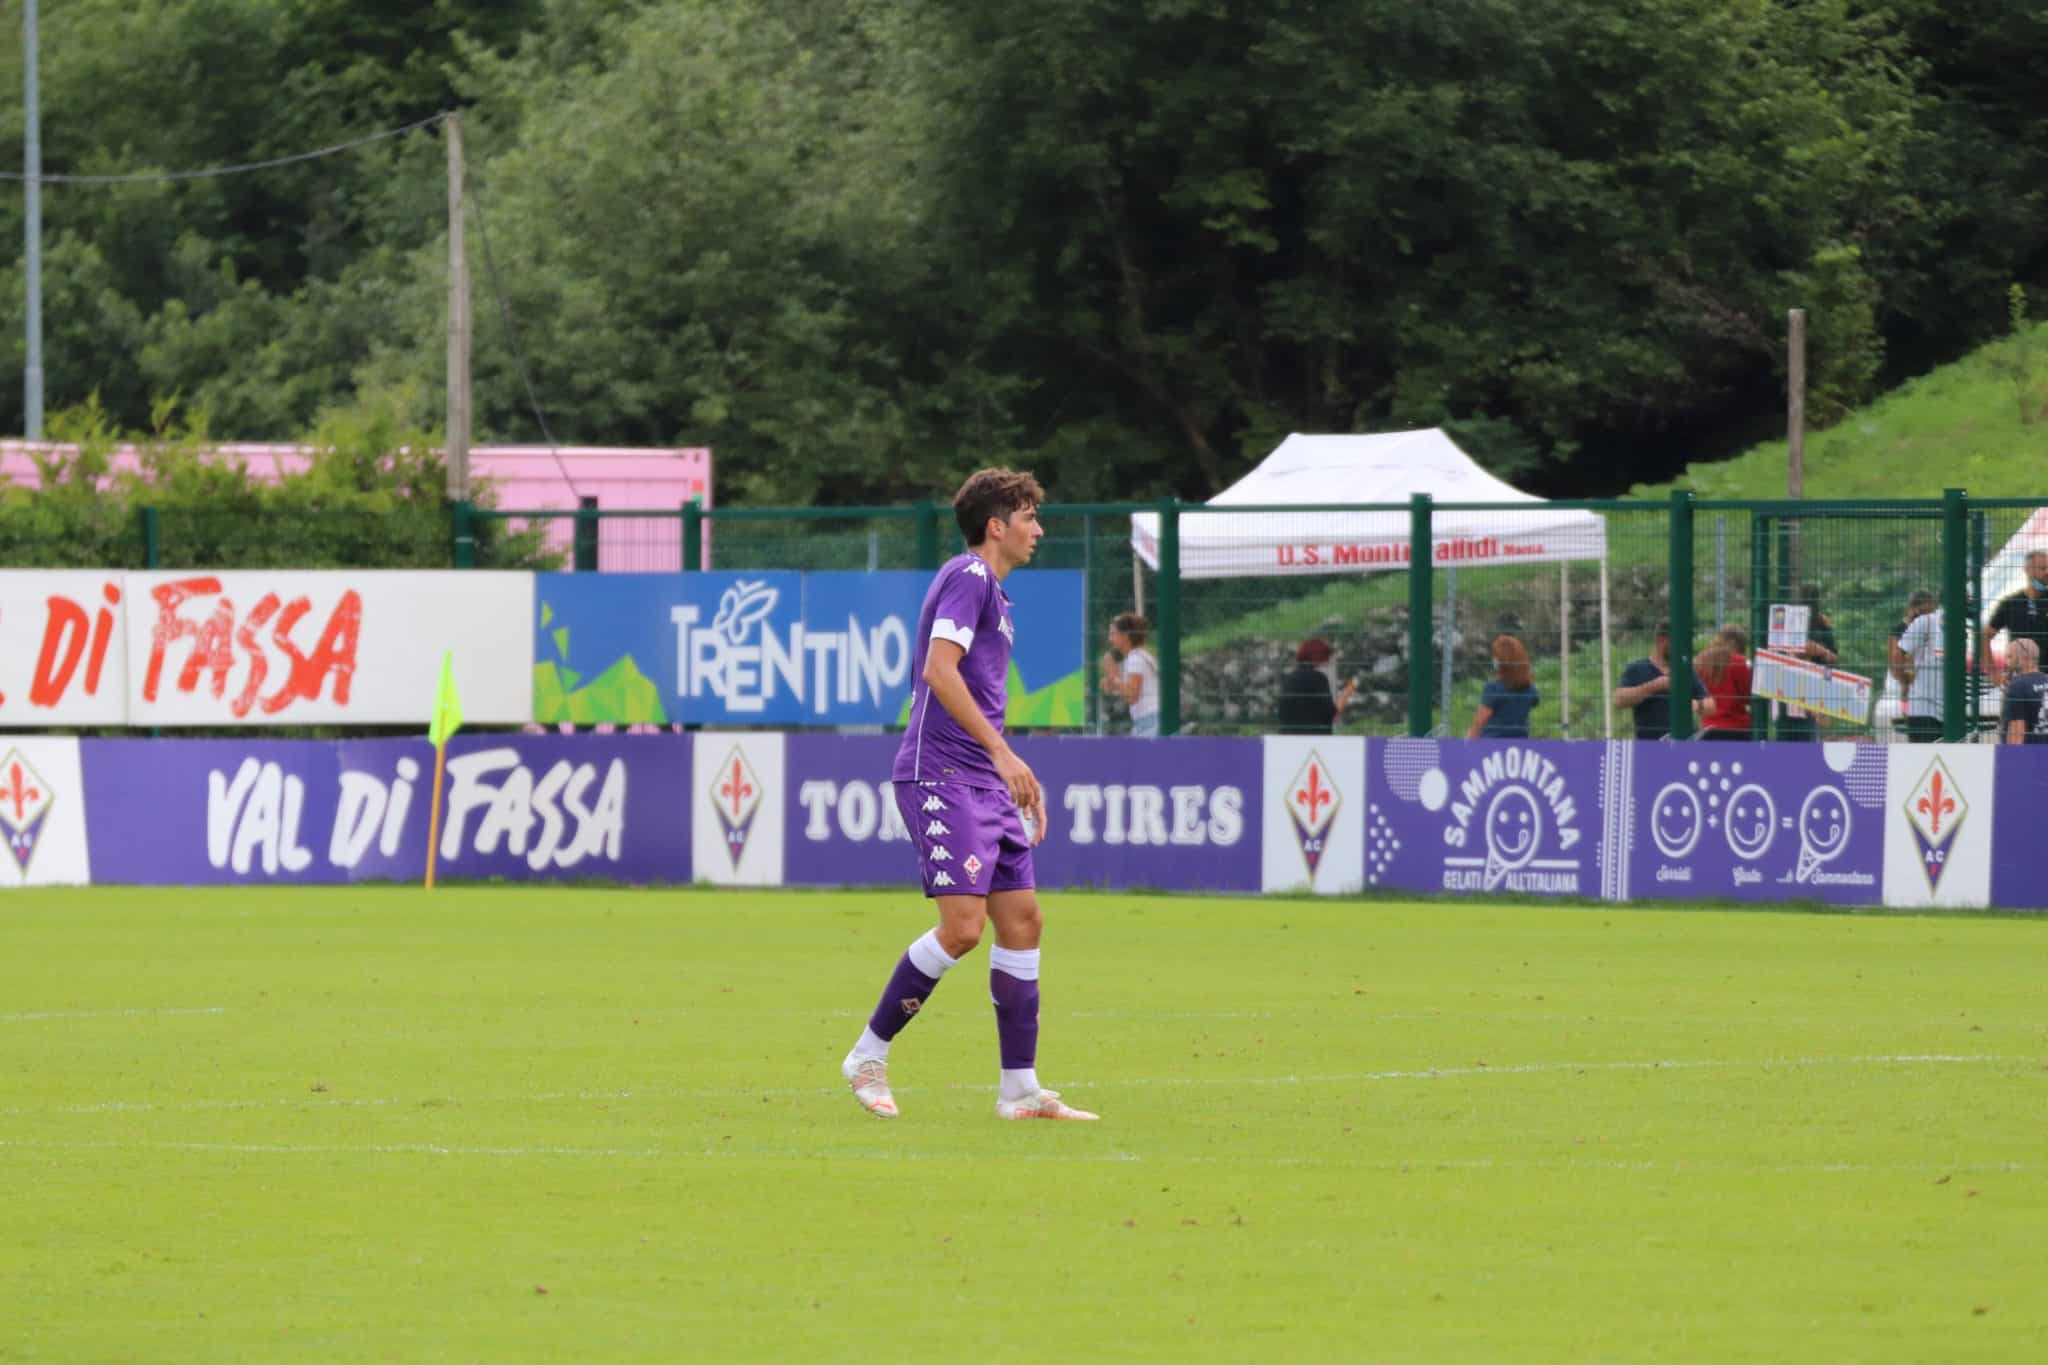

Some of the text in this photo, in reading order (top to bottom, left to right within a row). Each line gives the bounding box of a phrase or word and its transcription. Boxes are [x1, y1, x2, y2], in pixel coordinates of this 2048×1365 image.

[1276, 544, 1328, 567] U.S.
[671, 604, 909, 714] TRENTINO
[207, 757, 312, 874] VAL
[440, 748, 627, 870] FASSA
[1063, 784, 1243, 846] TIRES
[1443, 745, 1581, 851] SAMMONTANA
[1443, 870, 1482, 890] GELATI
